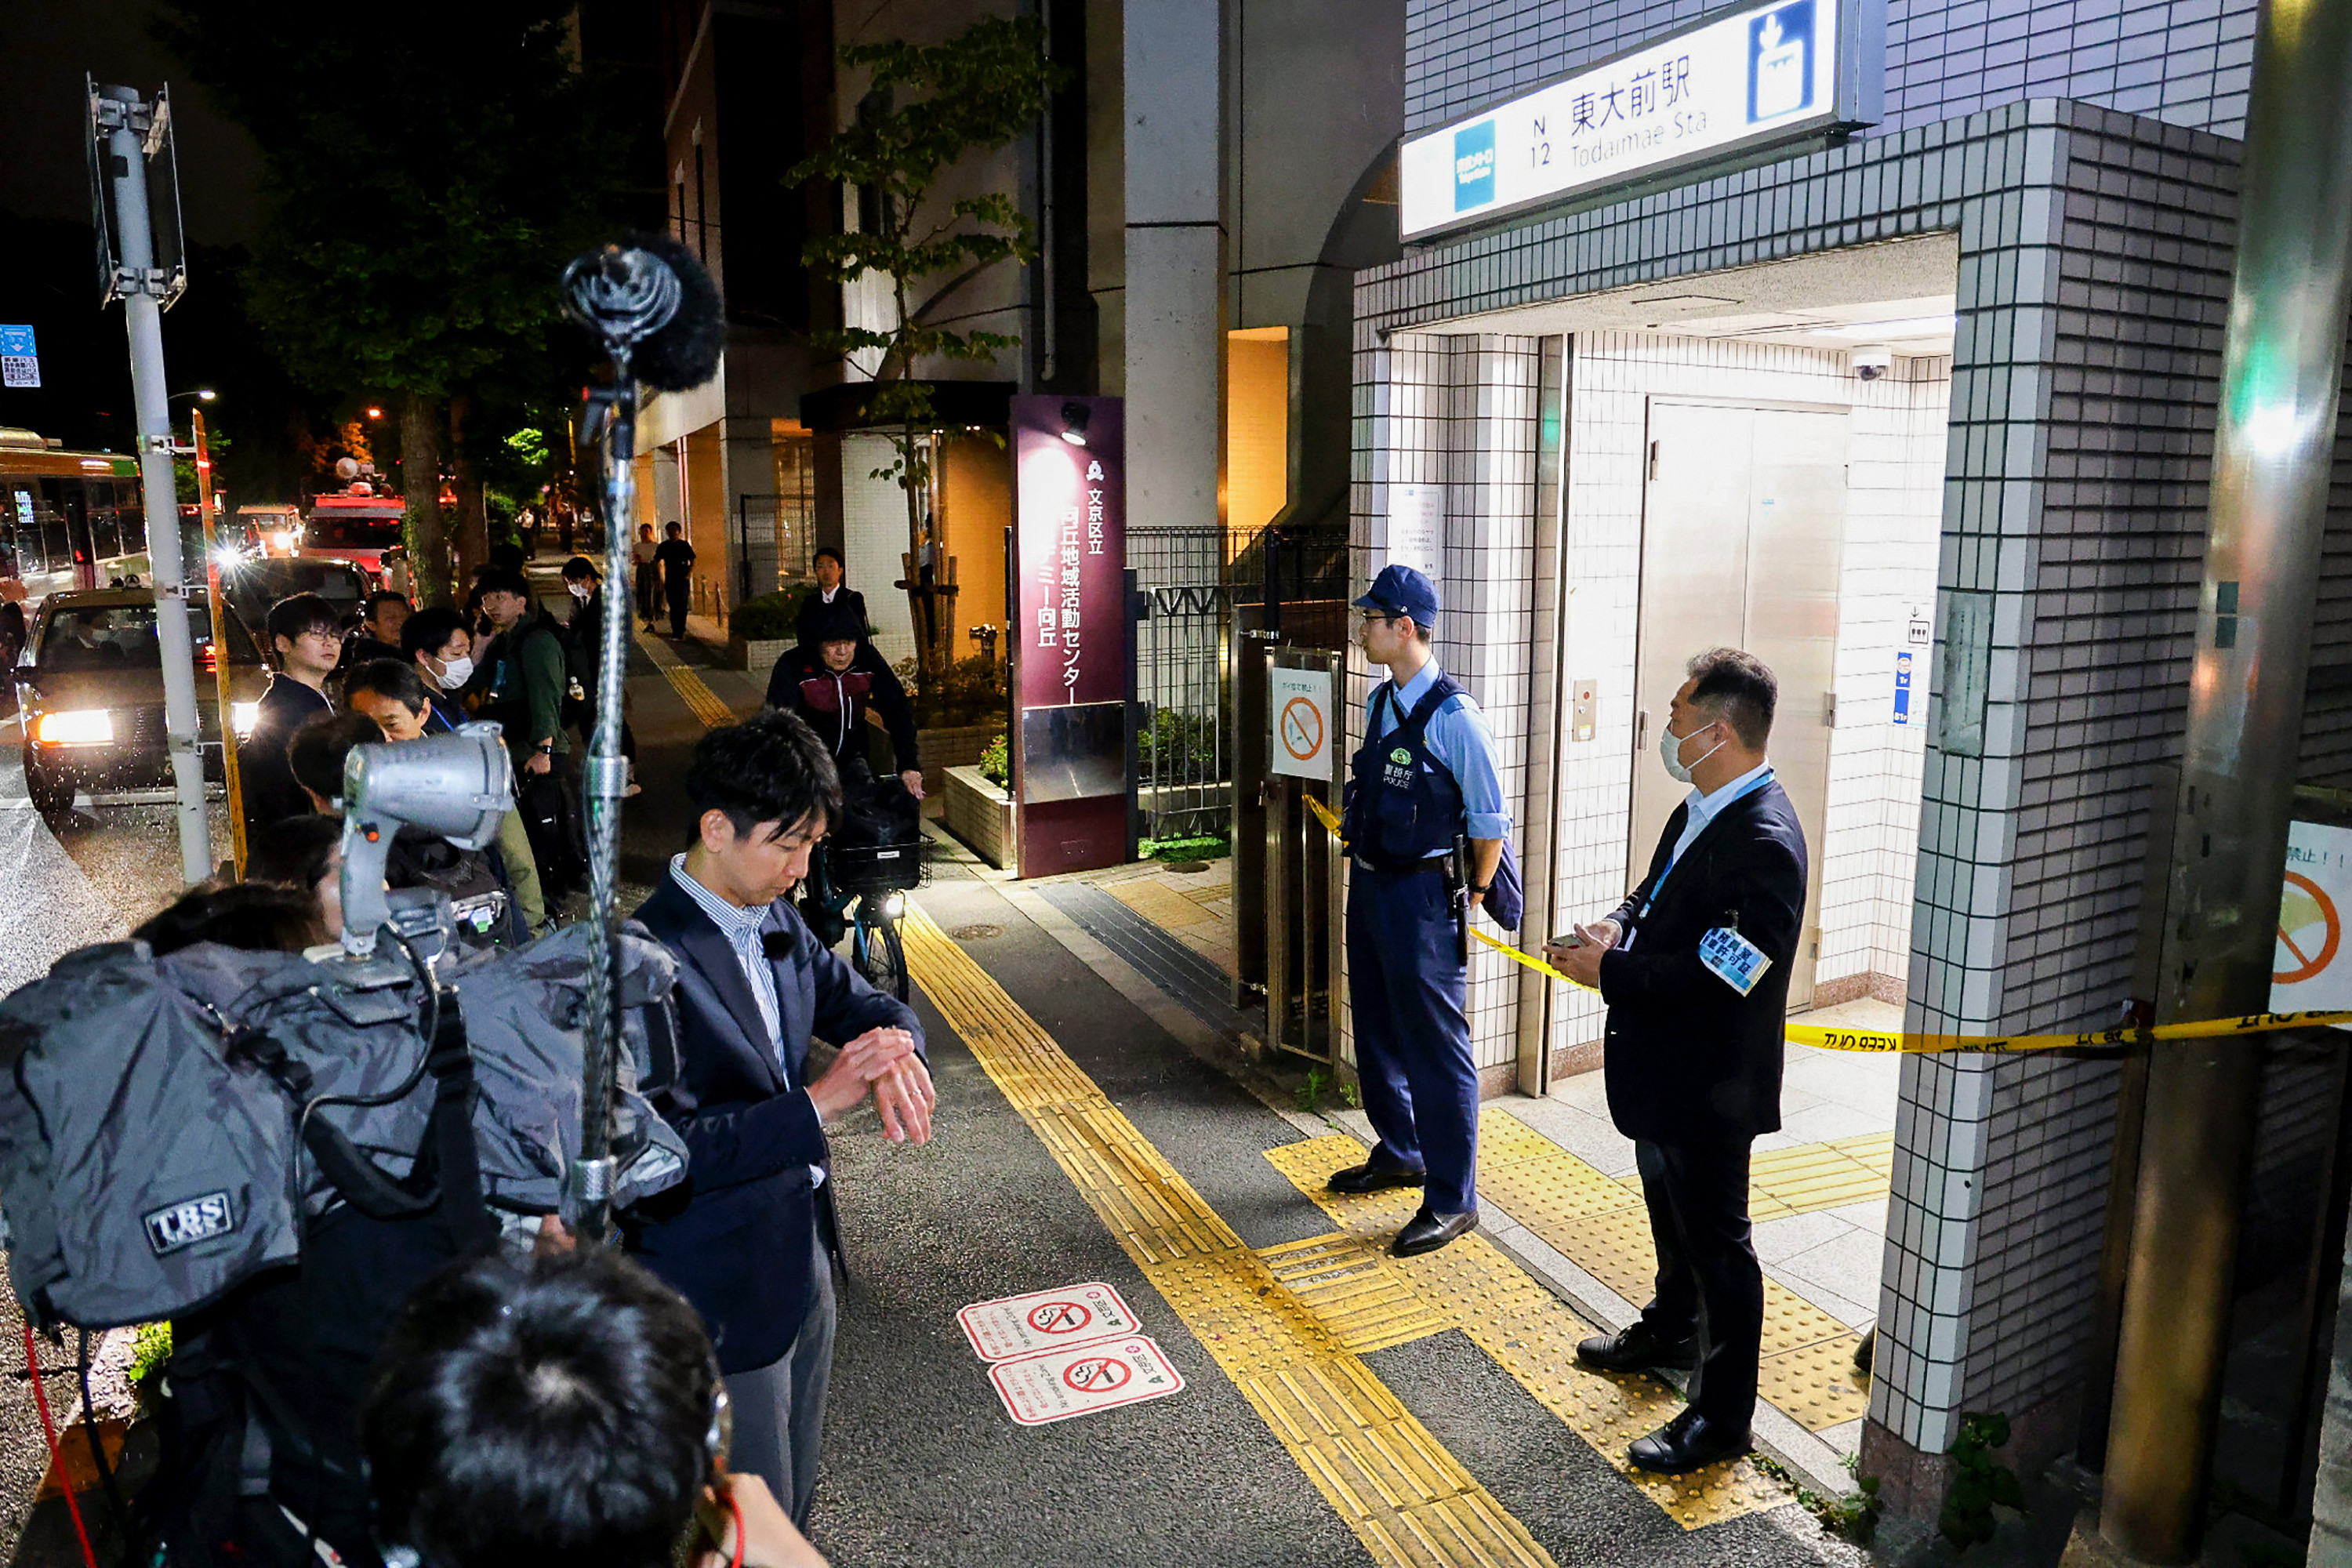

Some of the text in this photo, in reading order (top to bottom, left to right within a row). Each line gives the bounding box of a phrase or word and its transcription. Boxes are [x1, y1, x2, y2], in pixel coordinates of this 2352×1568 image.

[1571, 55, 1690, 136] 東大前駅
[1533, 115, 1545, 138] N
[1571, 125, 1664, 167] Todaimae
[1531, 142, 1550, 169] 12
[1088, 488, 1104, 554] 文京区立
[1060, 506, 1080, 705] 向丘地域活動センター
[151, 1197, 223, 1241] TBS
